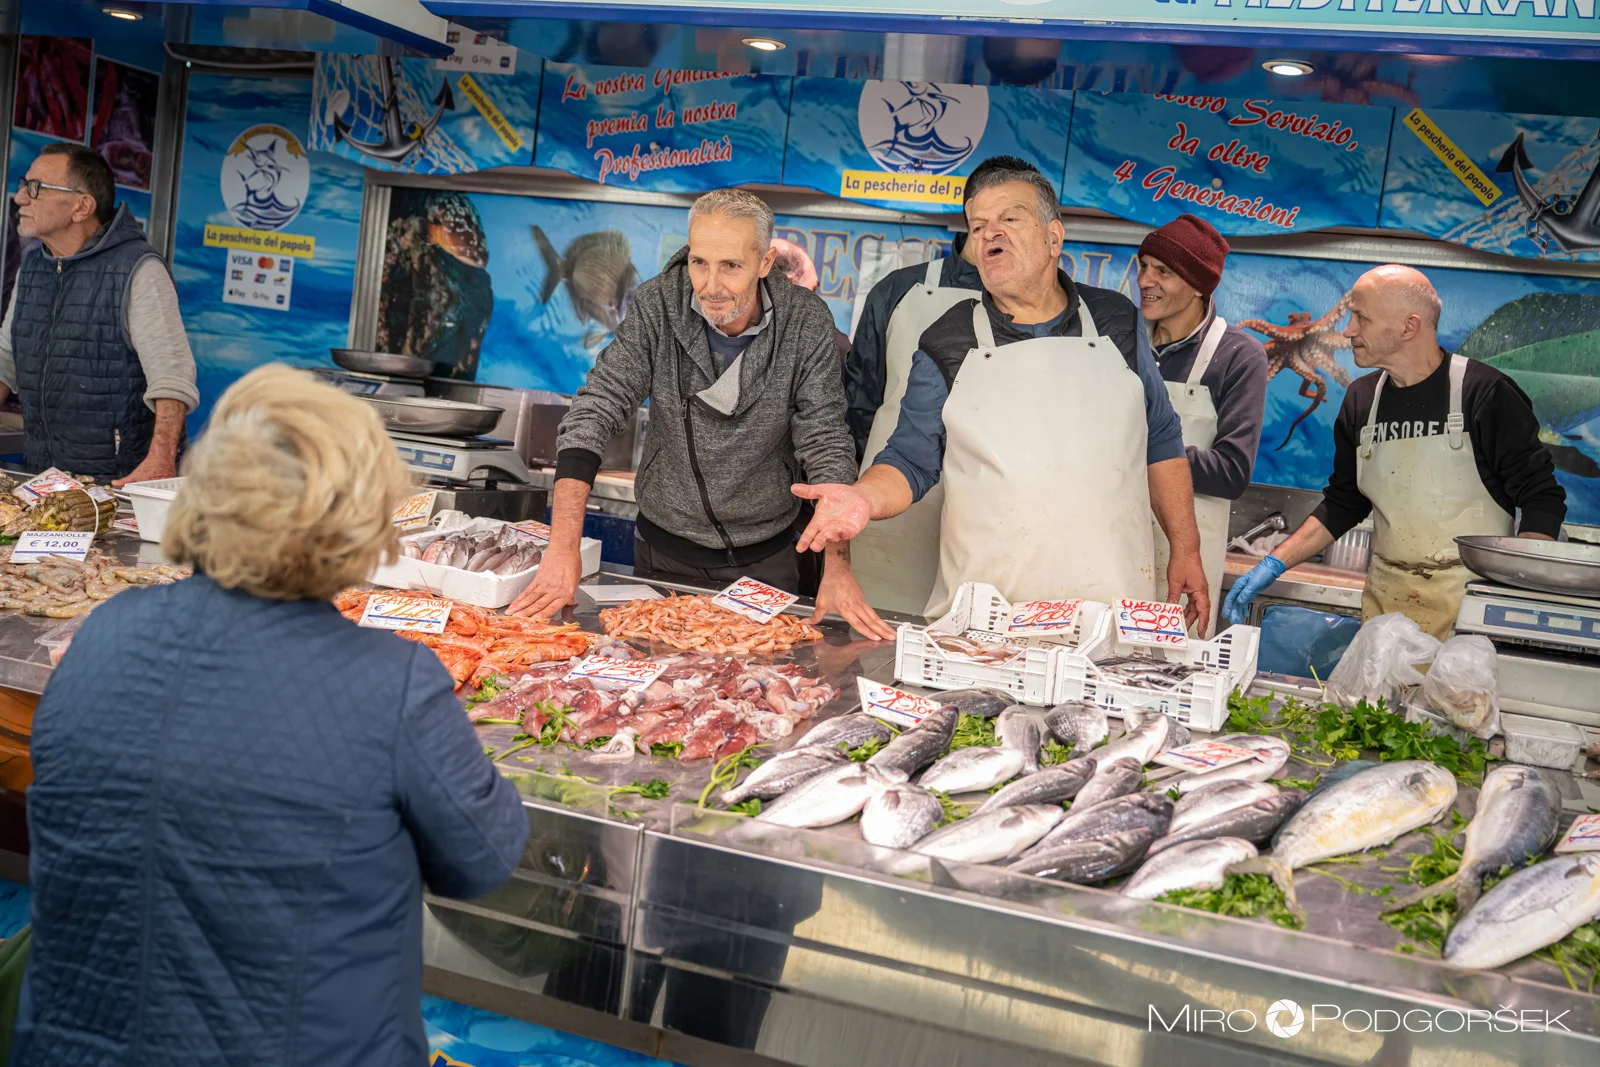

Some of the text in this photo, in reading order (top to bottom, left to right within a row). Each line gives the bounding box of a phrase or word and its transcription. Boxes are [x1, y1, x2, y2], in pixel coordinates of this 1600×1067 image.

[561, 74, 587, 103] La
[595, 73, 646, 97] vostra
[586, 100, 737, 148] premia la nostra
[1228, 98, 1358, 151] Servizio,
[594, 135, 733, 184] Professionalità
[1167, 122, 1270, 174] da oltre
[1409, 111, 1495, 200] La pescheria del popolo
[845, 176, 860, 189] La
[864, 178, 925, 194] pescheria
[930, 181, 950, 195] del
[1113, 160, 1301, 228] 4 Generazioni
[207, 229, 217, 240] La
[219, 233, 262, 246] pescheria
[264, 236, 278, 247] del
[232, 255, 254, 266] VISA
[234, 289, 246, 299] Pay
[1013, 615, 1025, 624] €
[1120, 611, 1128, 620] €
[869, 691, 878, 699] €
